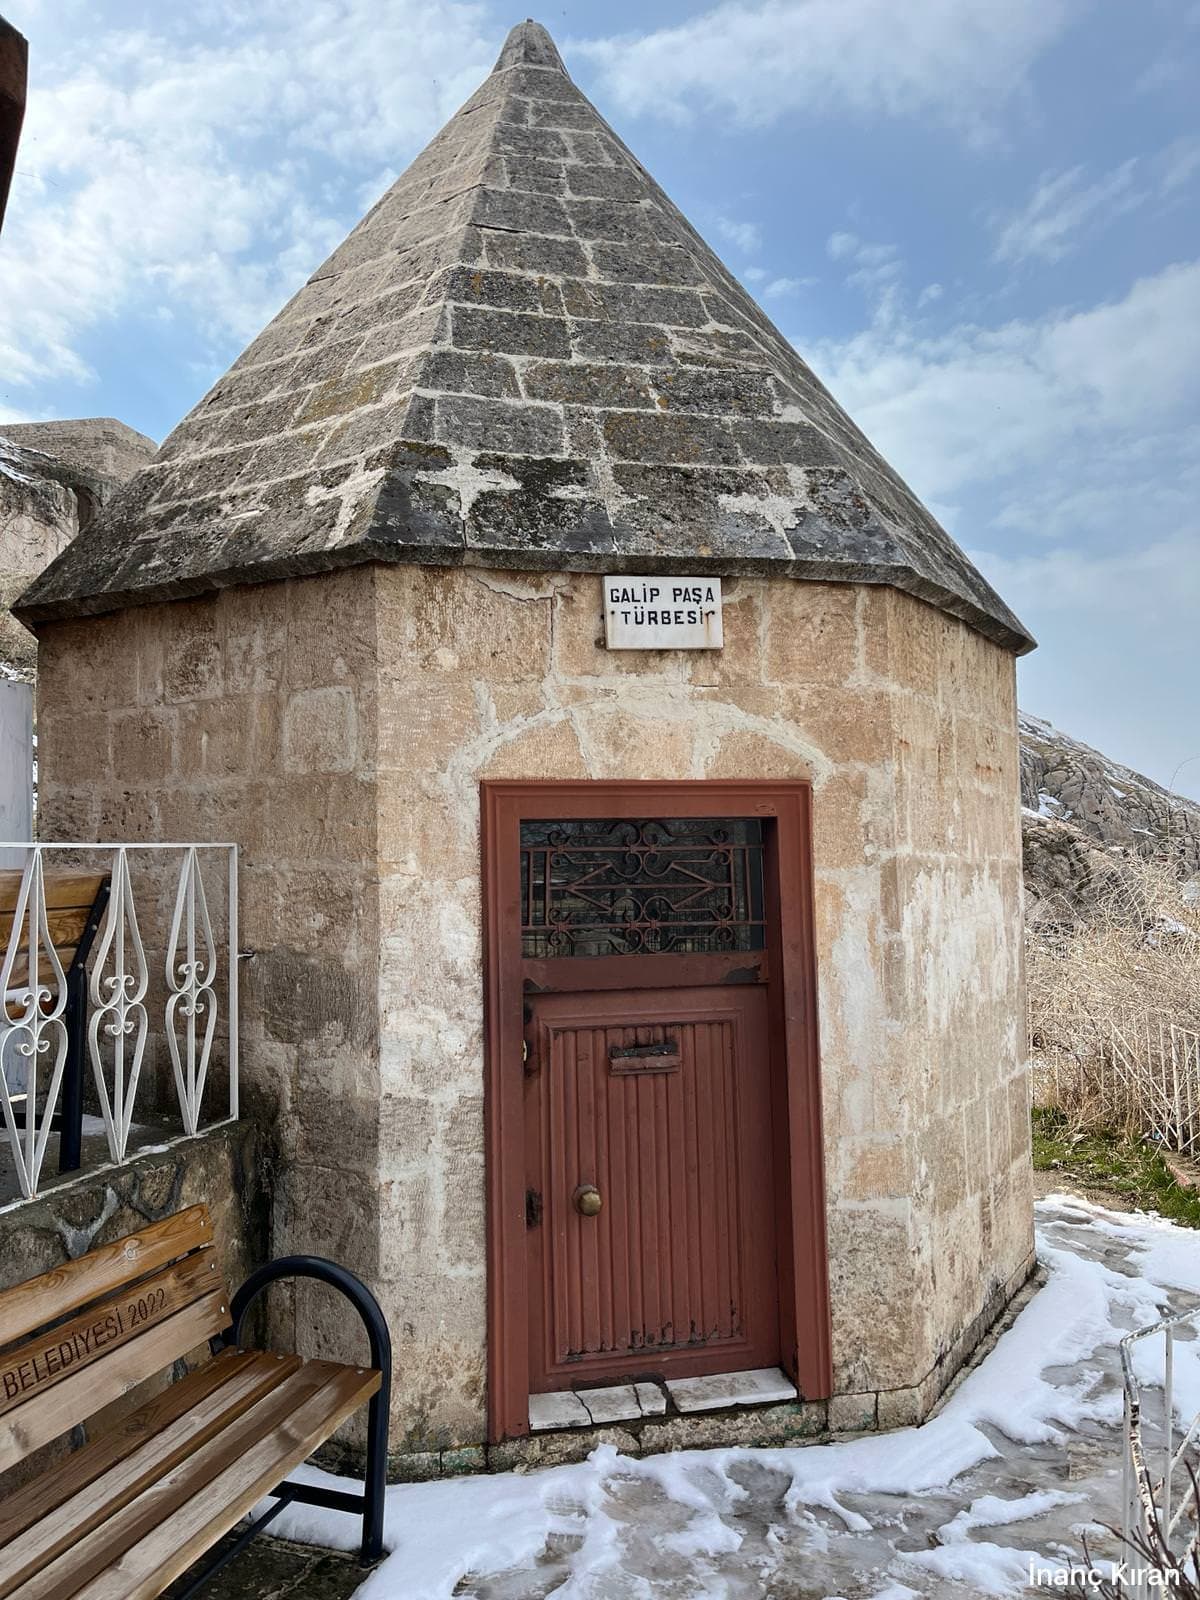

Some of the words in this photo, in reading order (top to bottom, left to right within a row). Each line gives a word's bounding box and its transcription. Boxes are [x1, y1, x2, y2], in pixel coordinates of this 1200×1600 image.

[610, 583, 660, 603] GALİP
[672, 587, 714, 605] PAŞA
[621, 606, 703, 625] TÜRBESİ
[3, 1307, 124, 1400] BELEDİYESİ
[128, 1288, 167, 1327] 2022
